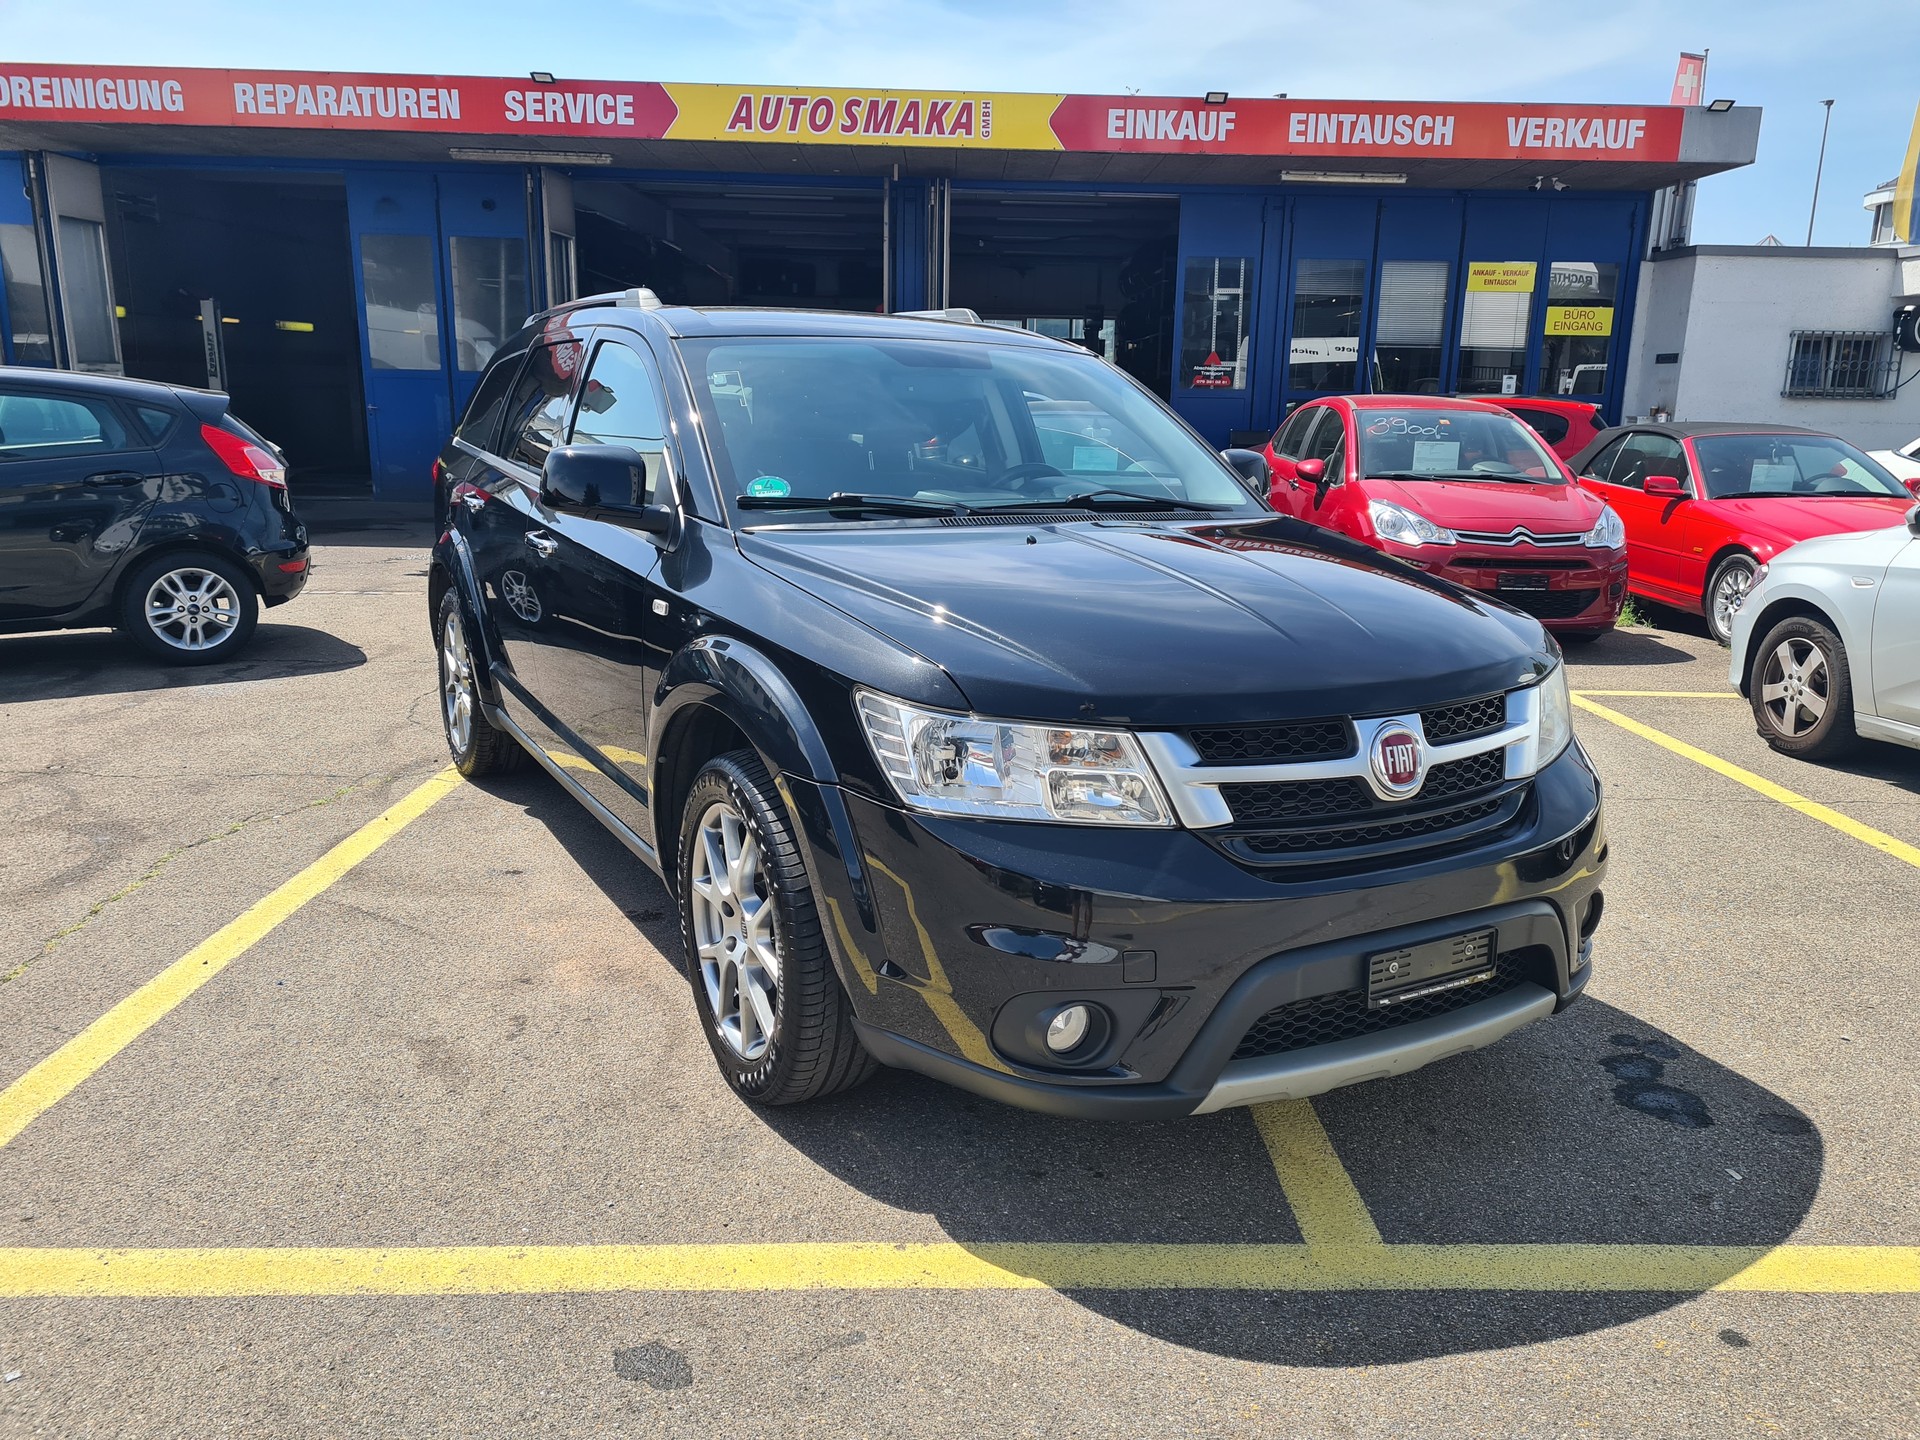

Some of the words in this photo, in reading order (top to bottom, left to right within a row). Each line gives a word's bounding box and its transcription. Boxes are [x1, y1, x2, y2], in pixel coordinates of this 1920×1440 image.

[233, 82, 461, 120] REPARATUREN
[503, 89, 635, 126] SERVICE
[725, 93, 837, 135] AUTO
[837, 97, 976, 139] SMAKA
[979, 100, 993, 139] GMBH
[1106, 108, 1236, 142] EINKAUF
[1288, 112, 1455, 147] EINTAUSCH
[1506, 117, 1646, 149] VERKAUF
[1472, 269, 1497, 277] ANKAUF
[1502, 269, 1530, 277] VERKAUF
[1483, 278, 1517, 286] EINTAUSCH
[1553, 321, 1604, 331] EINGANG
[1563, 309, 1596, 320] BÜRO
[1385, 742, 1415, 775] FIAT
